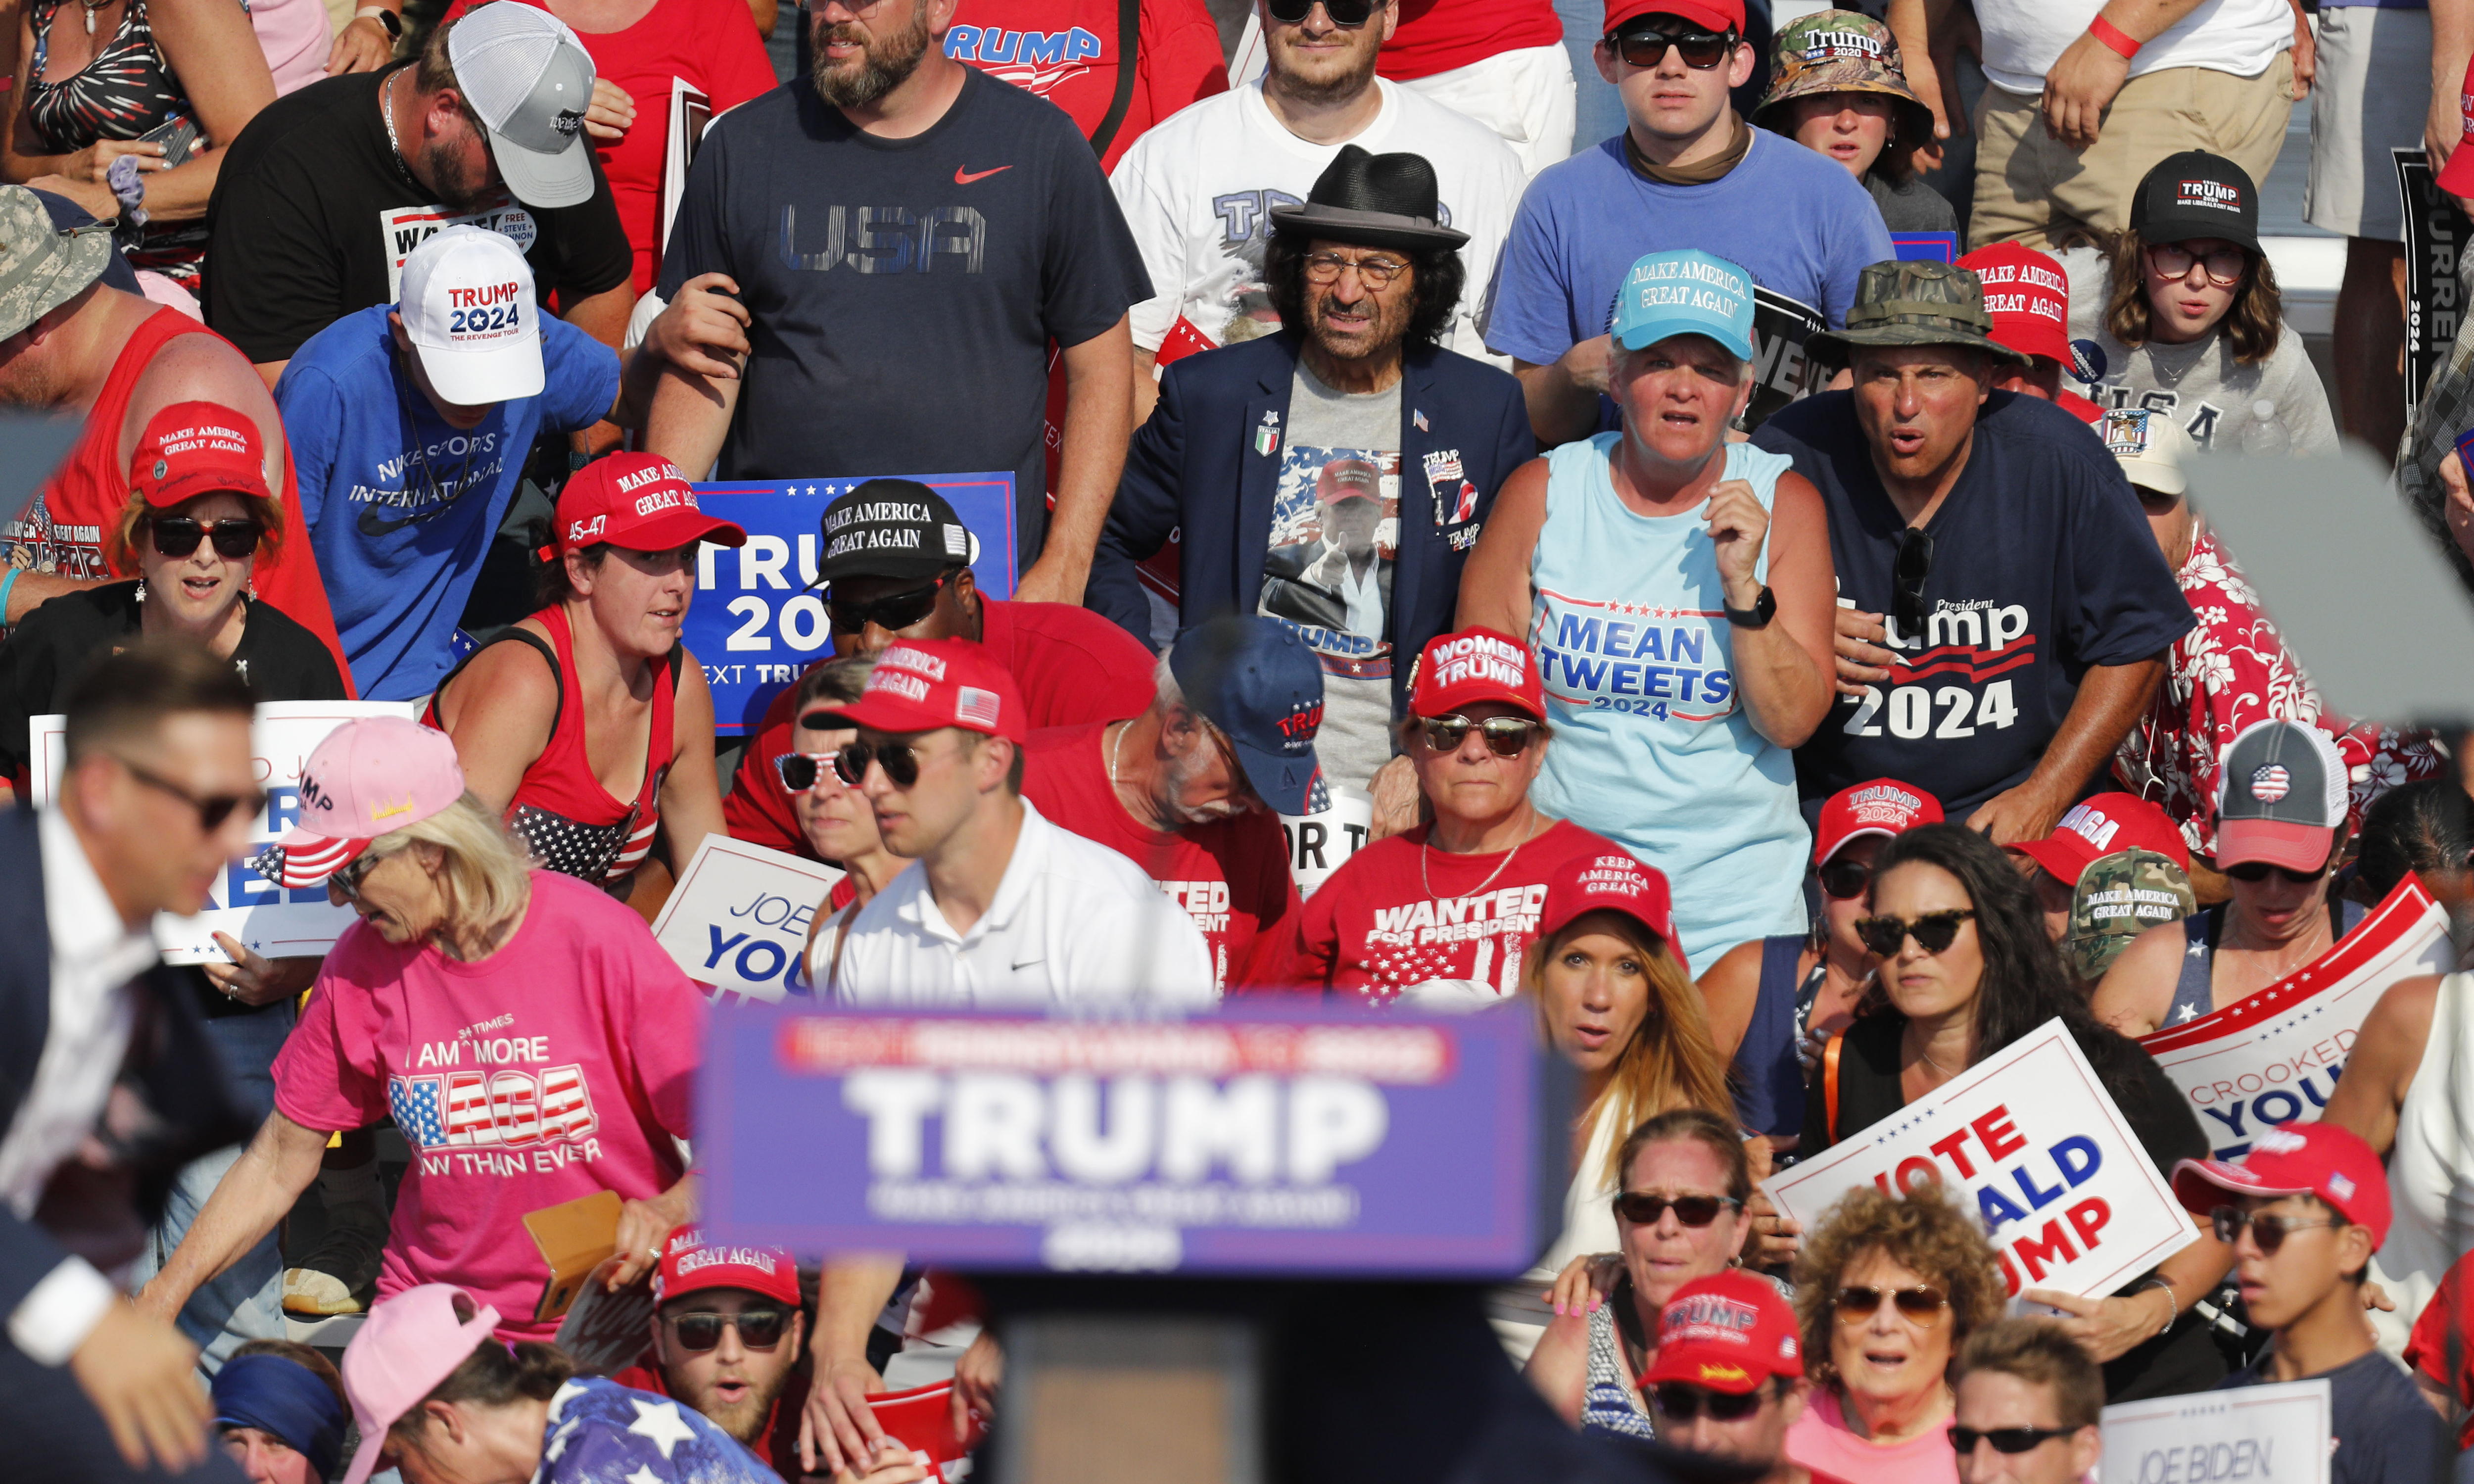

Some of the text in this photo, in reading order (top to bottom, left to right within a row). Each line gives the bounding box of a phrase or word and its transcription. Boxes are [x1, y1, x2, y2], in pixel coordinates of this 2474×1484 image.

[943, 24, 1101, 64] RUMP
[1805, 29, 1881, 58] Trump
[1834, 48, 1861, 57] 2020
[2182, 183, 2236, 201] TRUMP
[504, 224, 526, 233] STEVE
[505, 213, 525, 223] FREE
[779, 204, 986, 275] USA
[448, 281, 519, 308] TRUMP
[1632, 261, 1747, 300] MAKE AMERICA
[1976, 265, 2065, 298] MAKE AMERICA
[1640, 286, 1739, 318] GREAT AGAIN
[1983, 294, 2062, 322] GREAT AGAIN
[450, 303, 520, 333] 2024
[2410, 299, 2421, 353] 2024
[466, 331, 503, 341] REVENGE
[503, 328, 520, 337] TOUR
[159, 426, 247, 446] MAKE AMERICA
[164, 439, 245, 456] GREAT AGAIN
[377, 450, 423, 482] NIKE
[617, 466, 661, 493] MAKE
[635, 489, 681, 516] GREAT
[569, 514, 607, 542] 45-47
[824, 502, 932, 535] MAKE AMERICA
[74, 526, 101, 543] AGAIN
[827, 528, 922, 559] GREAT AGAIN
[1936, 598, 1994, 612] President
[1433, 635, 1525, 668] WOMEN
[1557, 611, 1706, 664] MEAN
[705, 665, 746, 685] EXT
[1435, 659, 1524, 688] TRUMP
[1540, 646, 1732, 705] TWEETS
[1594, 696, 1669, 722] 2024
[1843, 679, 2019, 739] 2024
[1850, 785, 1922, 809] TRUMP
[1856, 807, 1908, 827] 2024
[1595, 856, 1636, 869] KEEP
[1577, 869, 1649, 890] AMERICA
[1586, 881, 1639, 898] GREAT
[1374, 883, 1549, 933] WANTED
[2087, 889, 2180, 907] MAKE AMERICA
[2093, 904, 2173, 920] GREAT AGAIN
[730, 892, 816, 936] JOE
[1366, 928, 1416, 947] FOR
[457, 1013, 515, 1040] 34 TIMES
[417, 1040, 460, 1068] AM
[473, 1036, 551, 1064] MORE
[388, 1063, 599, 1153] MAGA
[841, 1066, 1391, 1184] TRUMP
[456, 1152, 528, 1178] THAN
[533, 1138, 603, 1173] EVER
[676, 1247, 726, 1277] GREAT
[728, 1247, 776, 1276] AGAIN
[2187, 1437, 2273, 1481] BIDEN
